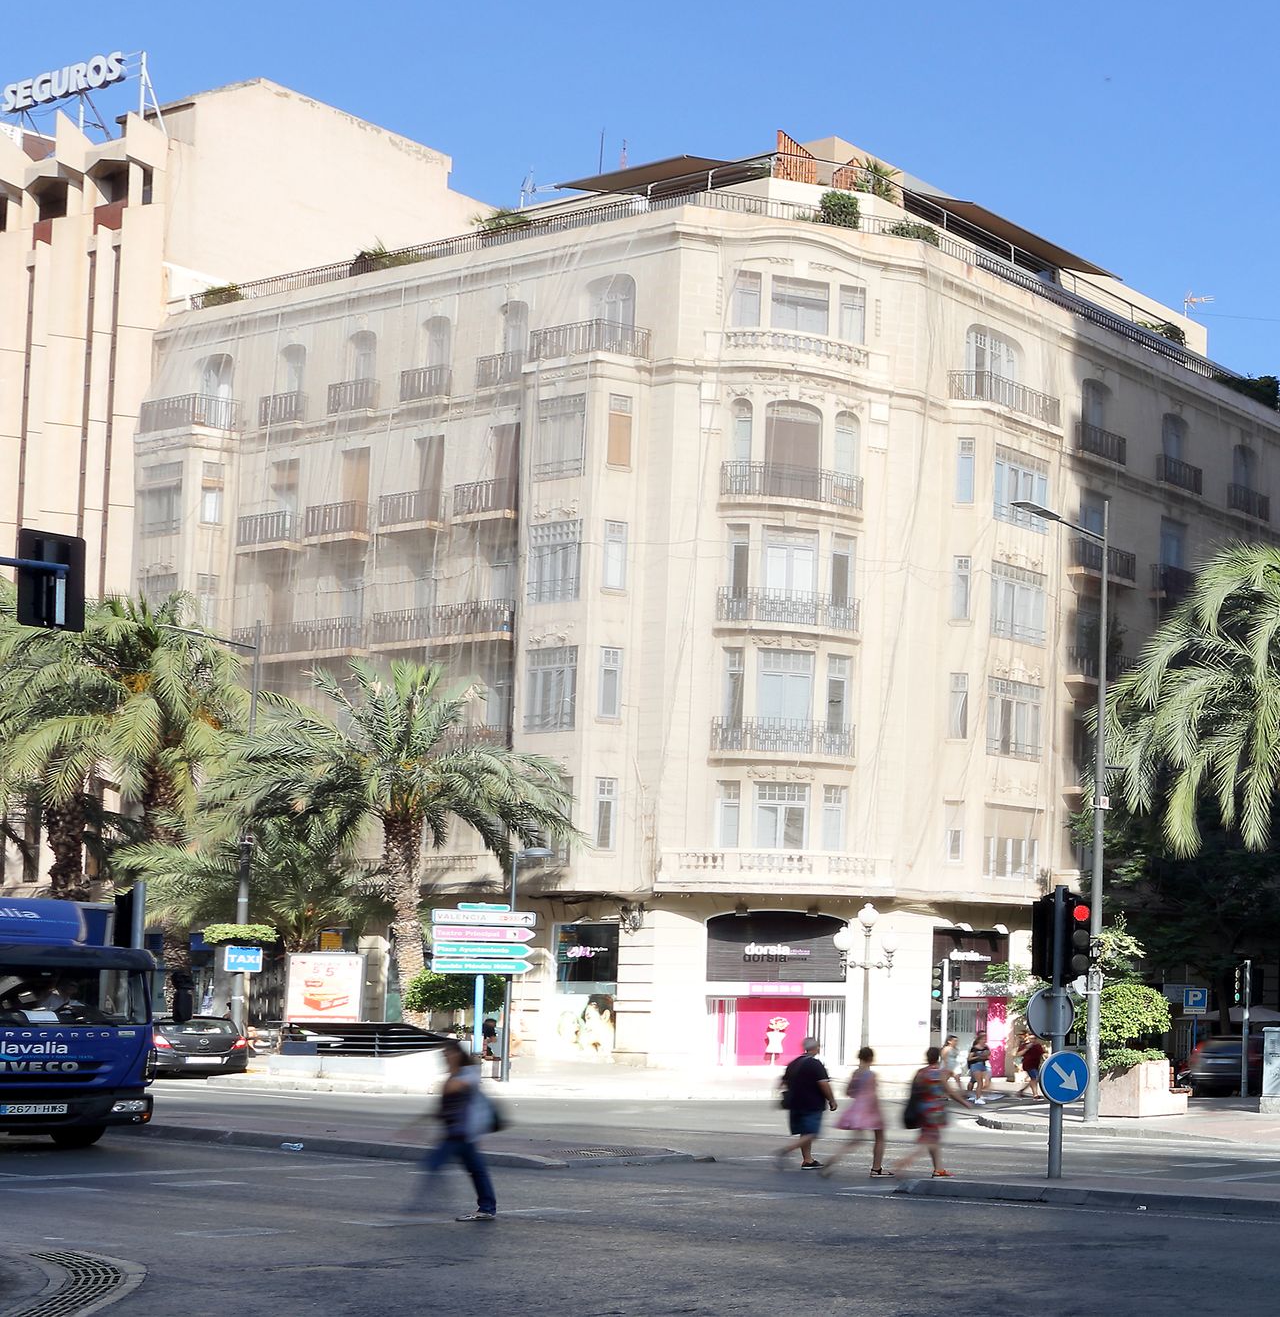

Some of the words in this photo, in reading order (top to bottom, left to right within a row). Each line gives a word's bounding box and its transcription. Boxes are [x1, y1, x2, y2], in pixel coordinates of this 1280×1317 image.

[2, 51, 127, 113] SEGUROS
[437, 913, 487, 922] VALENCIA
[745, 942, 790, 955] dorsia
[229, 955, 261, 964] TAXI
[1188, 990, 1203, 1005] P
[0, 1041, 69, 1055] lavalia
[0, 1061, 80, 1073] IVECO
[9, 1105, 38, 1114] 2671
